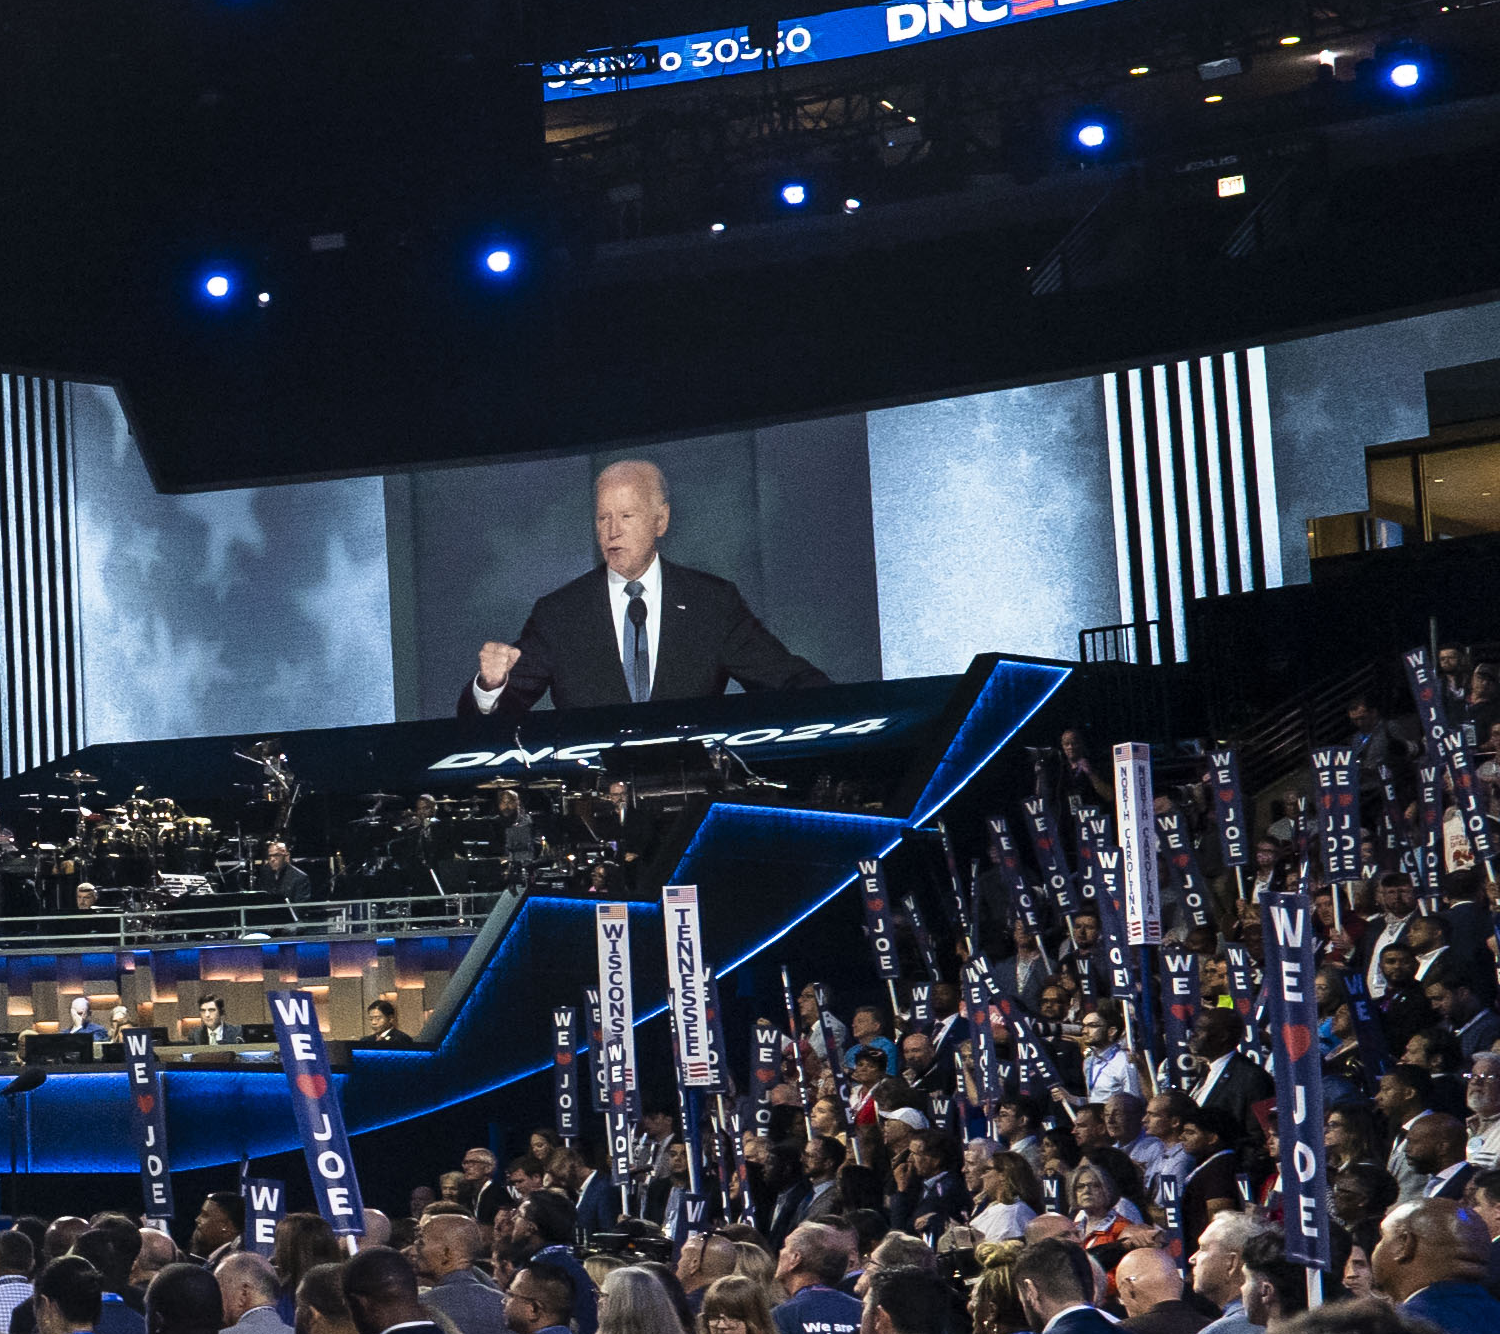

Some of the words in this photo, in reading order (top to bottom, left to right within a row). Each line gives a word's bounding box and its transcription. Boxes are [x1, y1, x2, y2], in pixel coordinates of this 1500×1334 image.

[1406, 650, 1427, 685] WE
[1428, 706, 1446, 757] JOE
[1312, 750, 1332, 787] WE
[1443, 730, 1467, 769] WE
[1466, 795, 1489, 851] JOE
[1211, 751, 1232, 786] WE
[1224, 807, 1242, 857] JOE
[1025, 798, 1046, 832] WE
[1048, 857, 1071, 907] JOE
[1157, 815, 1182, 849] WE
[1182, 874, 1206, 927] JOE
[1426, 831, 1439, 887] JOE
[859, 861, 879, 894] WE
[874, 917, 891, 970] JOE
[1016, 875, 1038, 926] JOE
[674, 908, 701, 1057] TENNESSEE
[1165, 954, 1192, 995] WE
[1227, 948, 1247, 990] WE
[555, 1011, 572, 1047] WE
[912, 985, 929, 1020] WE
[608, 1043, 623, 1083] WE
[756, 1029, 778, 1063] WE
[1269, 907, 1306, 1004] WE
[1292, 1085, 1319, 1238] JOE
[128, 1034, 149, 1085] WE
[145, 1125, 167, 1205] JOE
[275, 997, 316, 1061] WE
[313, 1113, 354, 1217] JOE
[560, 1072, 573, 1128] JOE
[615, 1113, 628, 1175] JOE
[251, 1186, 280, 1245] WE
[802, 1321, 831, 1333] We
